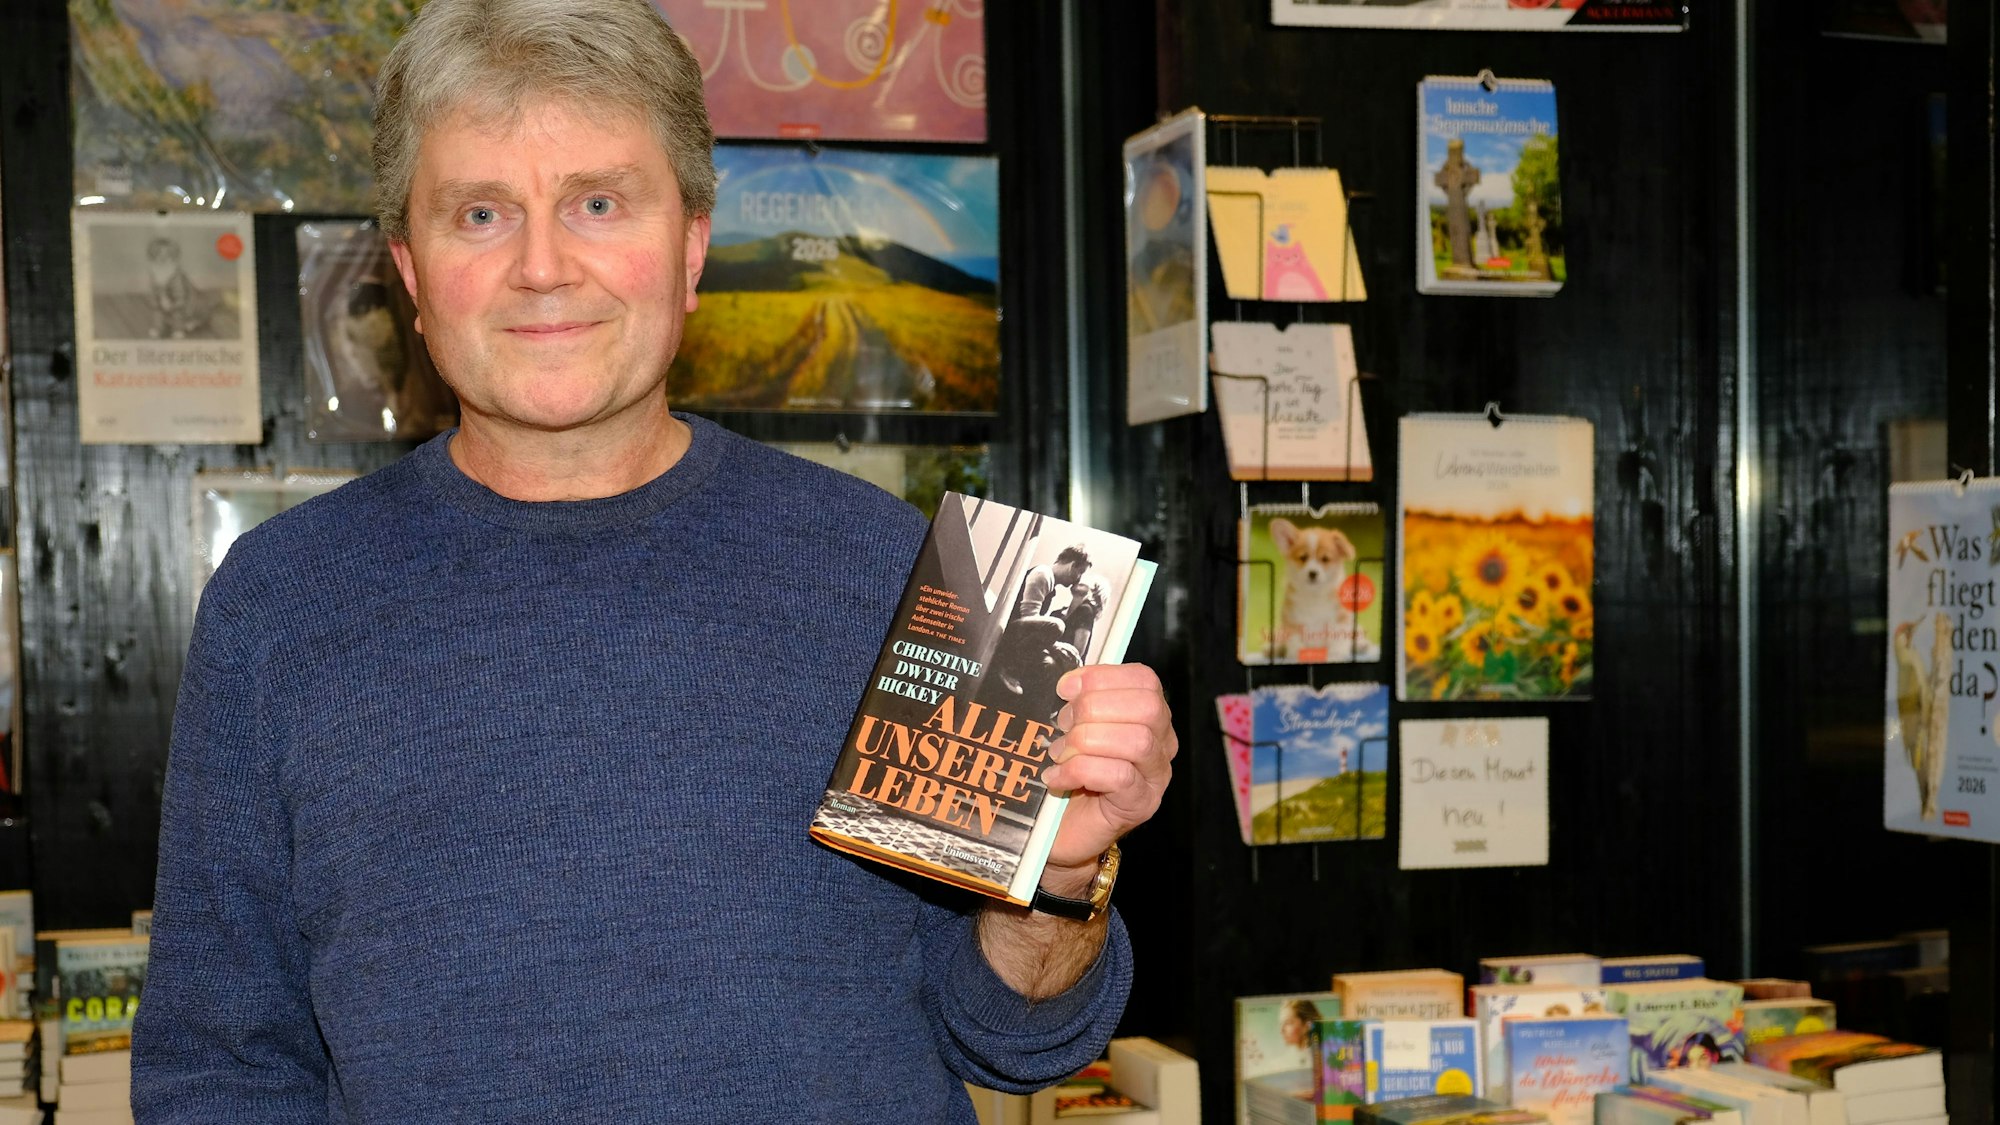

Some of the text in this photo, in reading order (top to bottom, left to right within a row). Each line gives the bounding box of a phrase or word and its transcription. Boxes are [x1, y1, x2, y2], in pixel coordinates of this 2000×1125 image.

[791, 236, 840, 262] 2026
[93, 346, 243, 366] Der literarische
[93, 369, 243, 389] Katzenkalender
[1927, 523, 1982, 561] Was
[919, 595, 971, 614] stehlicher Roman
[932, 588, 960, 600] unwider-
[1926, 568, 1997, 620] fliegt
[911, 613, 955, 631] Außenseiter in
[915, 604, 965, 623] über zwei irische
[936, 631, 948, 640] THE
[948, 635, 966, 645] TIMES
[892, 640, 983, 678] CHRISTINE
[894, 659, 959, 691] DWYER
[876, 675, 943, 706] HICKEY
[922, 695, 1055, 763] ALLE
[855, 714, 1039, 803] UNSERE
[1410, 755, 1537, 784] Diesen Monat
[846, 757, 1006, 837] LEBEN
[1957, 775, 1987, 795] 2026
[830, 798, 857, 814] Roman
[1442, 804, 1485, 828] neu
[942, 843, 1003, 874] Unionsverlag
[1519, 1027, 1566, 1039] PATRICIA
